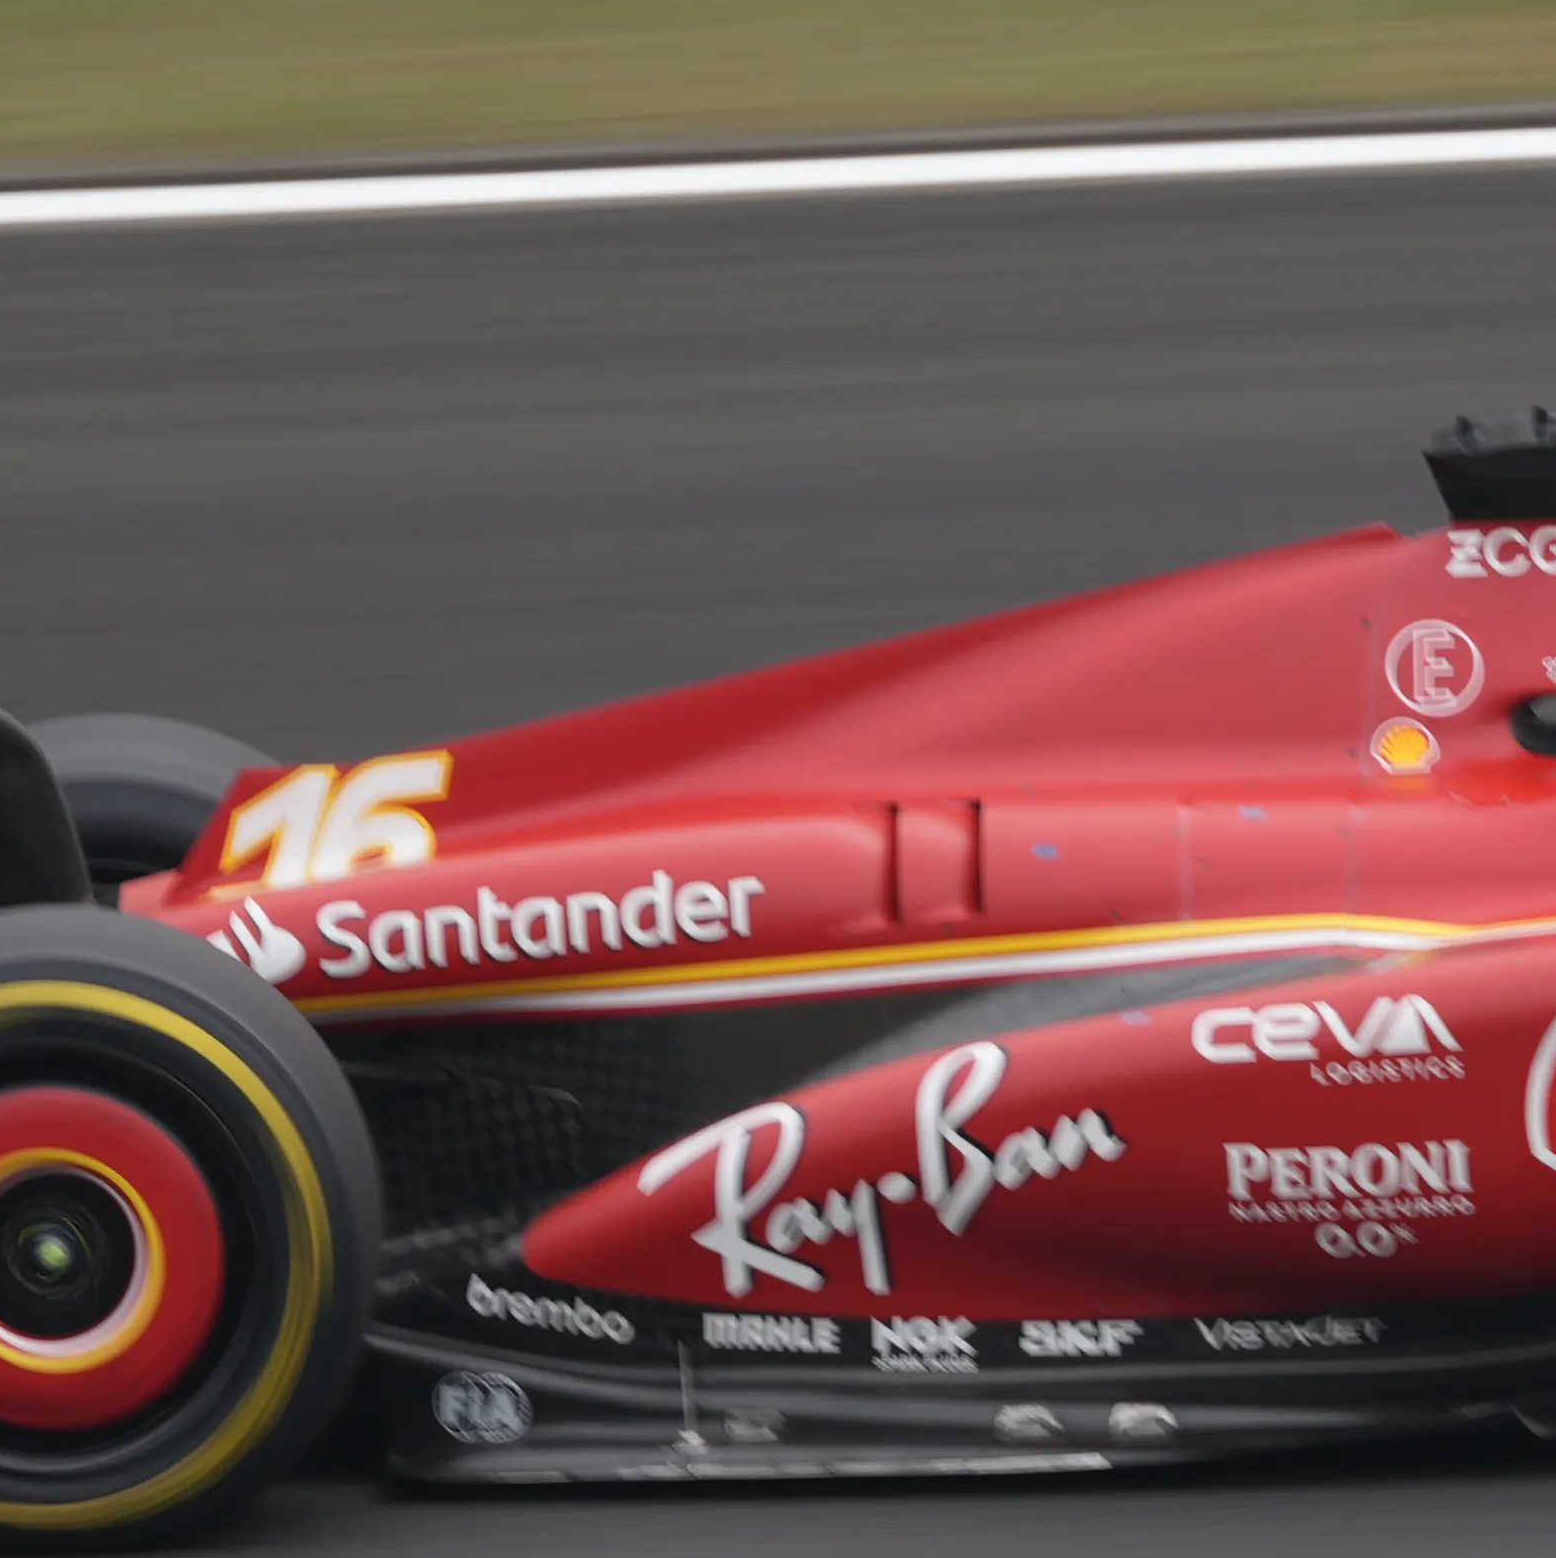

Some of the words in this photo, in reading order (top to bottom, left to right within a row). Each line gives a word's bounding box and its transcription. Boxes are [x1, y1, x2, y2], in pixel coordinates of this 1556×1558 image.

[207, 748, 455, 895] 16
[315, 868, 766, 980] Santander
[1309, 1054, 1466, 1086] LOGISTICS
[1222, 1139, 1475, 1201] PERONI
[1227, 1200, 1342, 1223] NASTRO
[1342, 1193, 1476, 1220] AZZURRO
[465, 1272, 636, 1345] brembo
[1018, 1319, 1144, 1357] SKF
